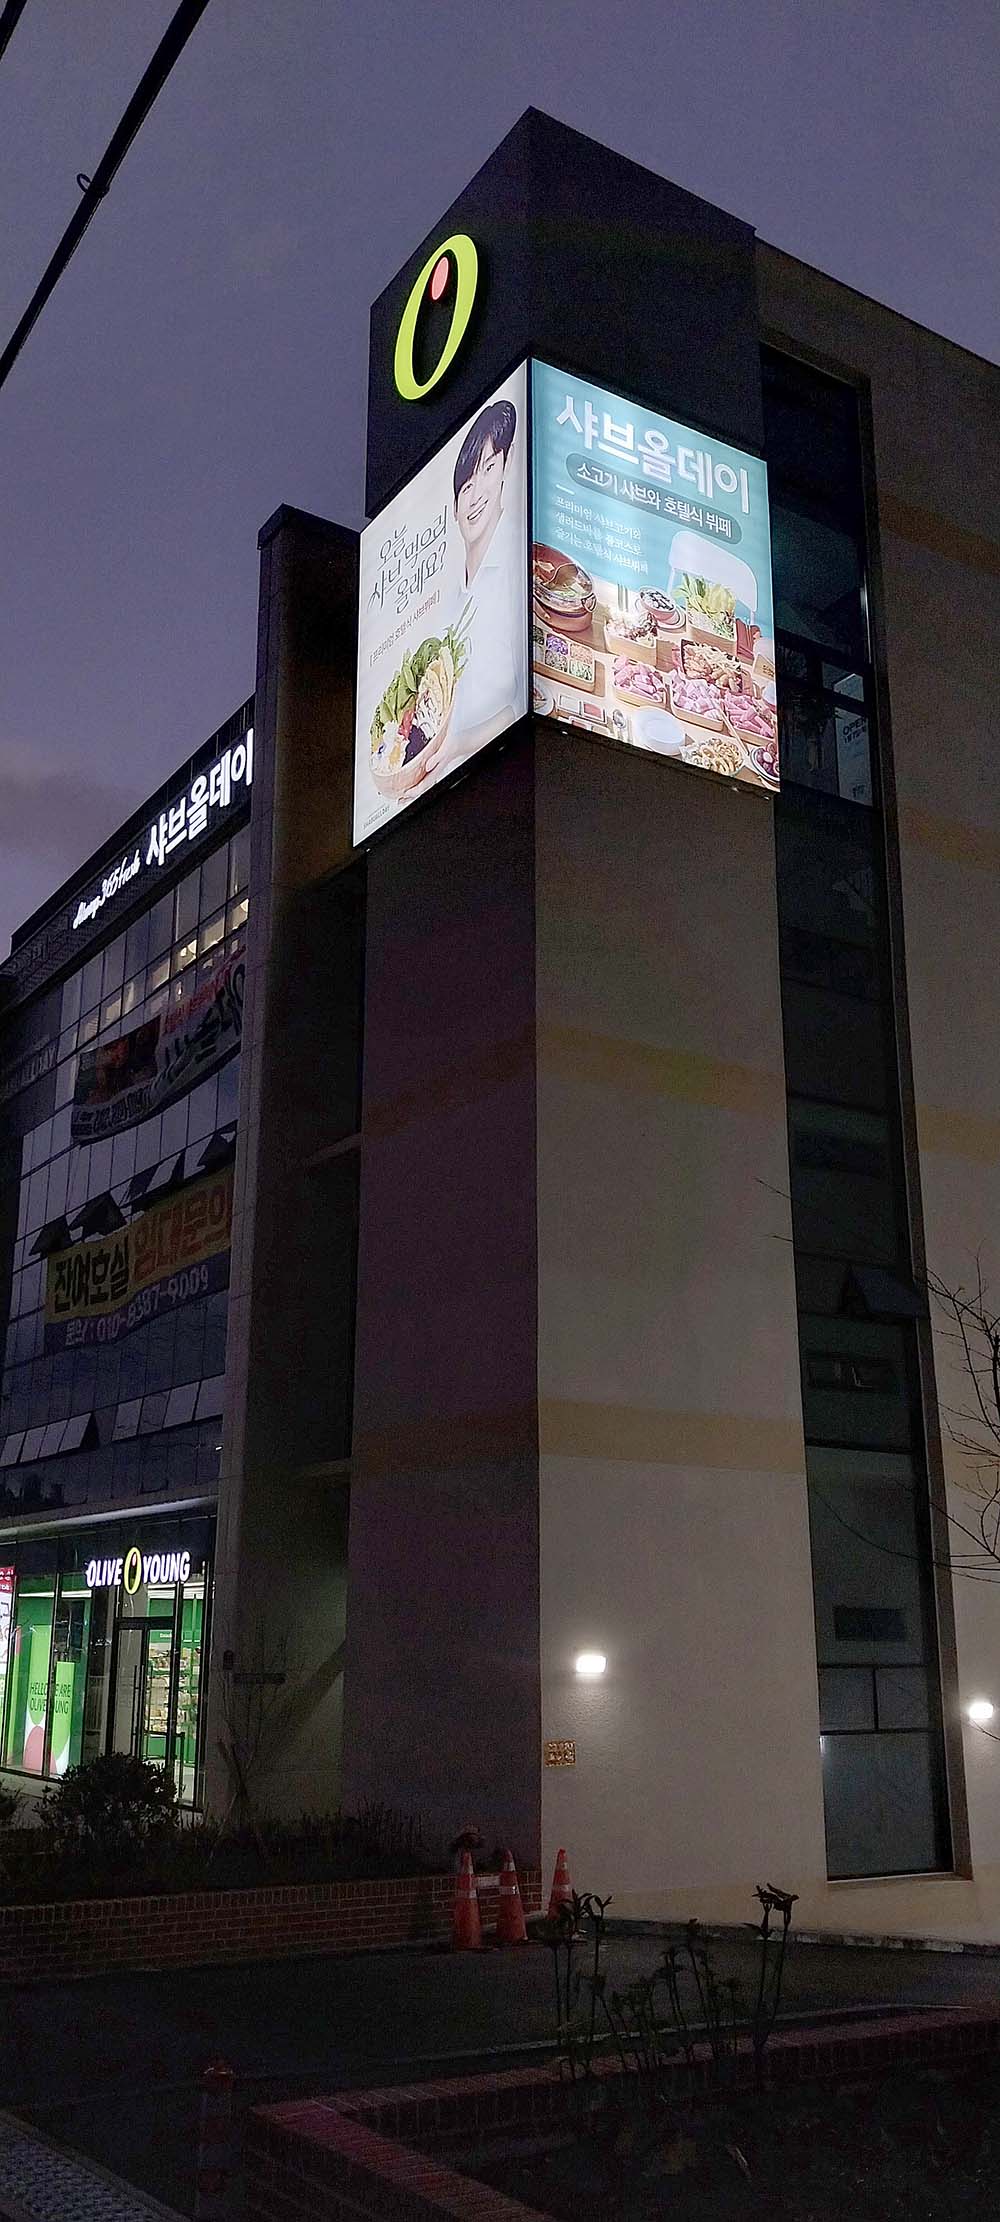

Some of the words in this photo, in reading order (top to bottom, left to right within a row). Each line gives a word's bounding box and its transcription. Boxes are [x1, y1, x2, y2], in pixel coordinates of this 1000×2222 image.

[556, 395, 750, 514] 샤브올데이
[576, 462, 618, 495] 소고기
[619, 479, 662, 511] 샤브와
[664, 496, 703, 527] 호텔식
[706, 511, 732, 539] 뷔페
[377, 524, 408, 571] 오늘
[394, 541, 447, 615] 올래요?
[146, 728, 254, 866] 샤브올데이
[54, 1235, 129, 1314] 잔여호실
[86, 1558, 123, 1588] OLIVE
[142, 1551, 190, 1584] YOUNG
